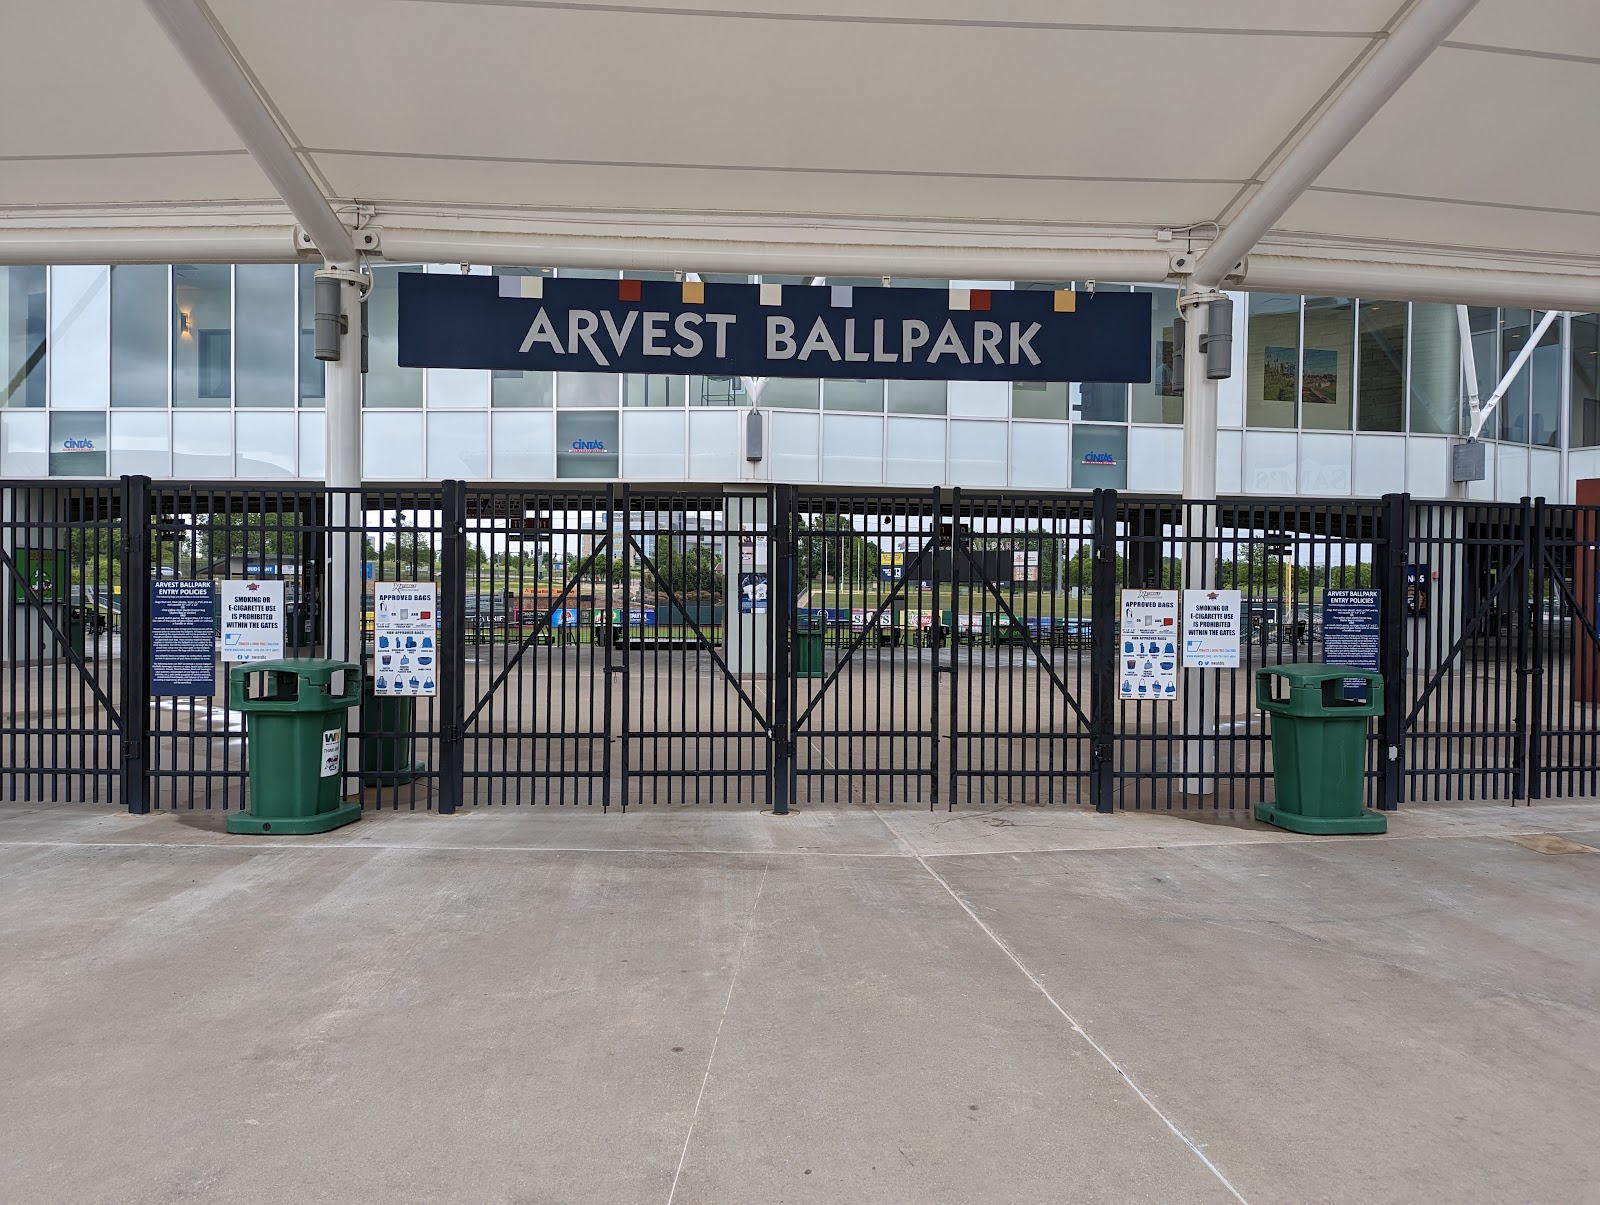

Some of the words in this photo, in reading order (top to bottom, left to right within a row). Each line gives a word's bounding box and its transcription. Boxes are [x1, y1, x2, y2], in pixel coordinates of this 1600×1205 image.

[518, 306, 737, 366] ARVEST
[766, 315, 1043, 365] BALLPARK
[572, 439, 604, 450] CINTAS
